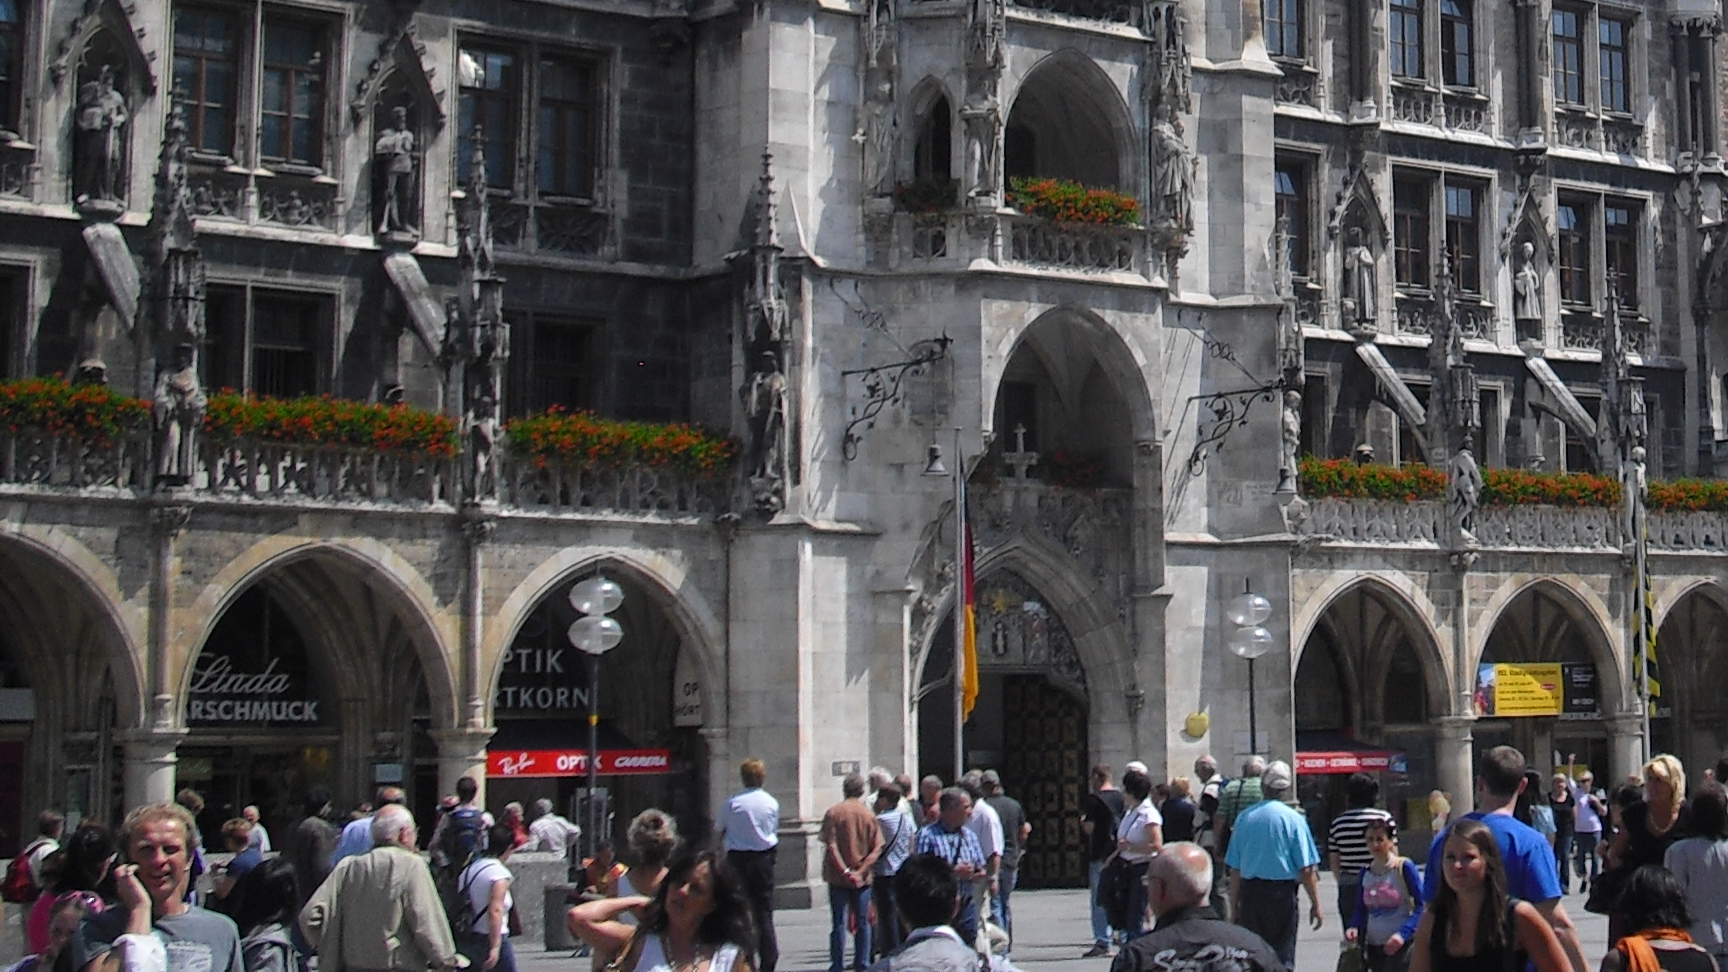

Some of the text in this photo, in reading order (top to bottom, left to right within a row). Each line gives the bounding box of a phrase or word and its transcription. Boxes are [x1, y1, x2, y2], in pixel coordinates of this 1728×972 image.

[188, 651, 291, 694] Linda
[183, 699, 319, 722] RSCHMUCK
[556, 755, 603, 771] OPTK
